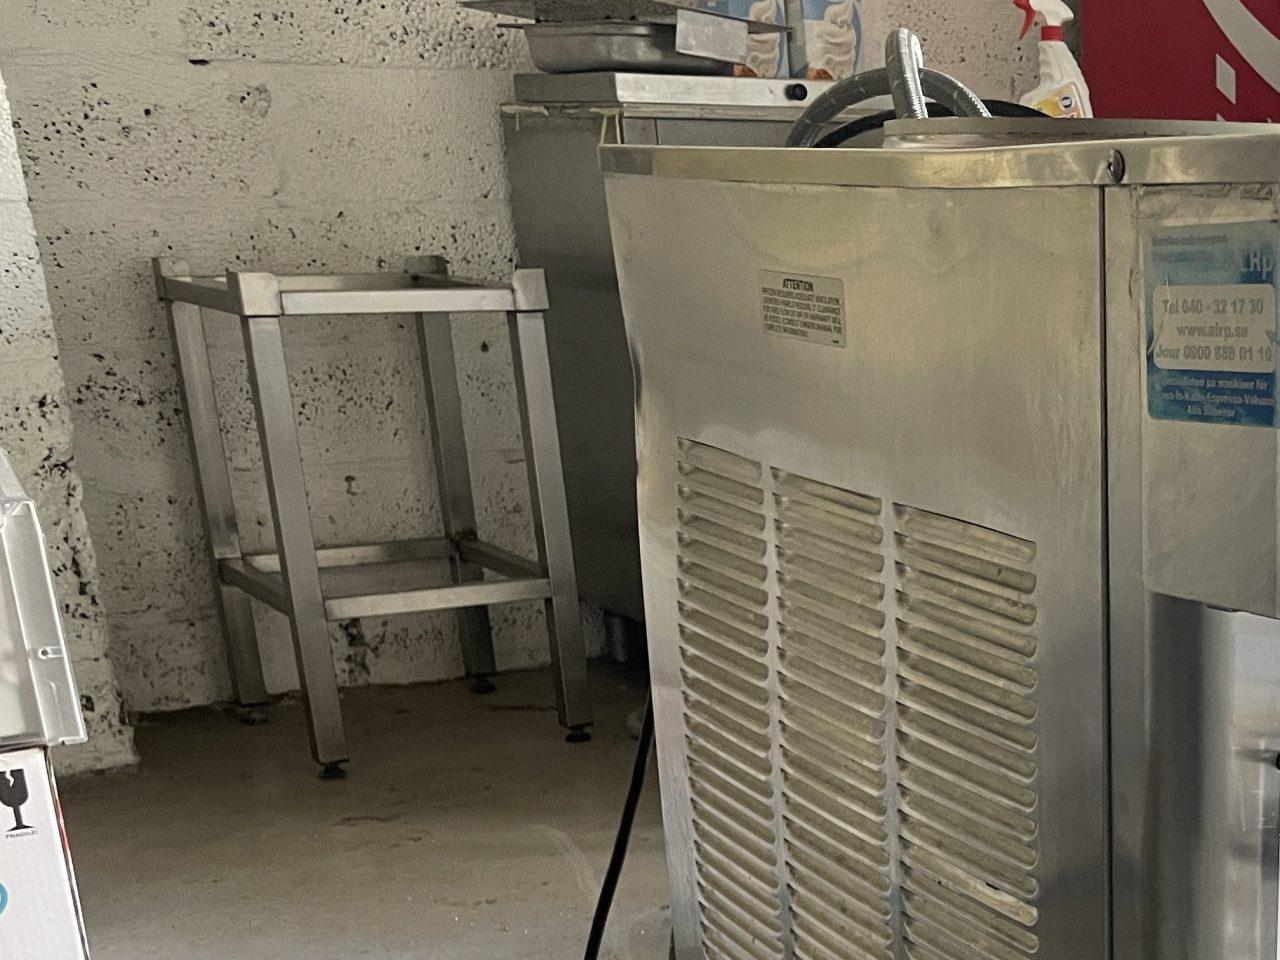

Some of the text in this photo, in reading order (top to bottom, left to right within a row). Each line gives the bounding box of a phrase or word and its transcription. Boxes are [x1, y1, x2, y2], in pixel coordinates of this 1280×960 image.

[782, 279, 814, 292] ATTENTION
[1163, 298, 1179, 314] Tel
[1182, 298, 1203, 314] 040
[1214, 298, 1228, 314] 32
[1230, 298, 1245, 314] 17
[1249, 298, 1264, 314] 30
